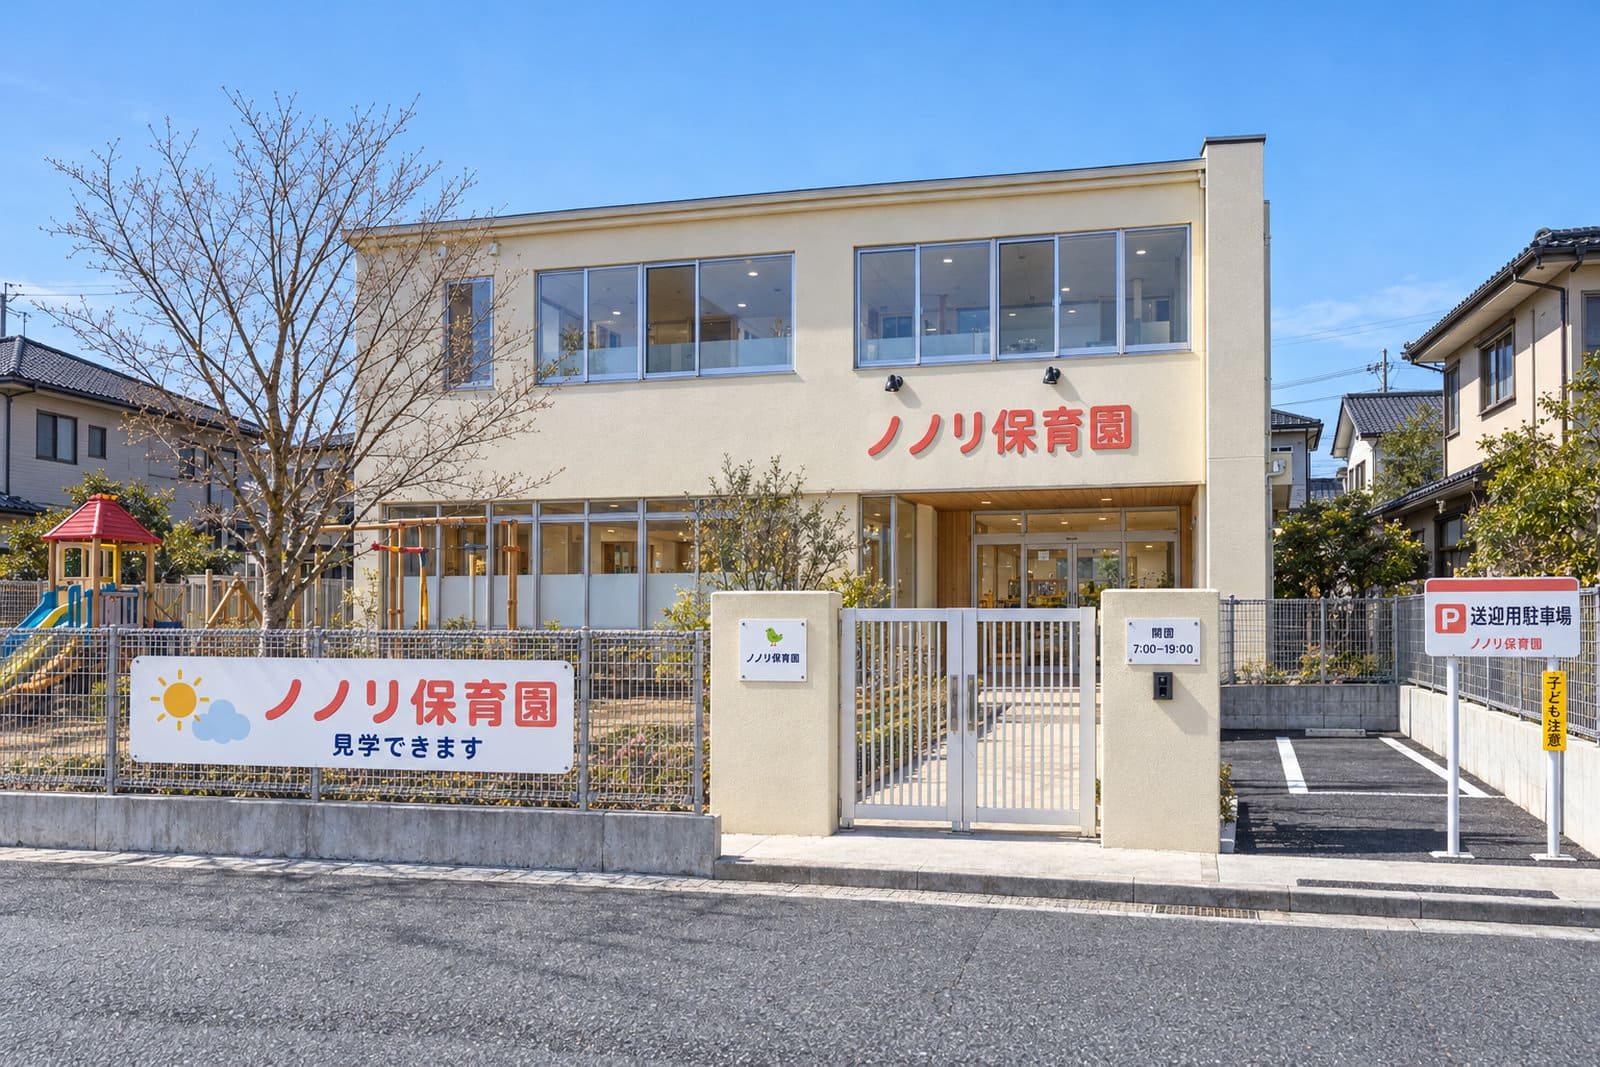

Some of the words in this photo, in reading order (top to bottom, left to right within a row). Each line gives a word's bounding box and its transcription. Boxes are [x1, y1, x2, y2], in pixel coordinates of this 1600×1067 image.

[867, 405, 1132, 457] ノノリ保育園
[1442, 608, 1460, 630] P
[1470, 605, 1572, 626] 送迎用駐車場
[265, 678, 557, 728] ノノリ保育園
[1546, 676, 1562, 747] 子ども注意
[332, 733, 484, 760] 見学できます
